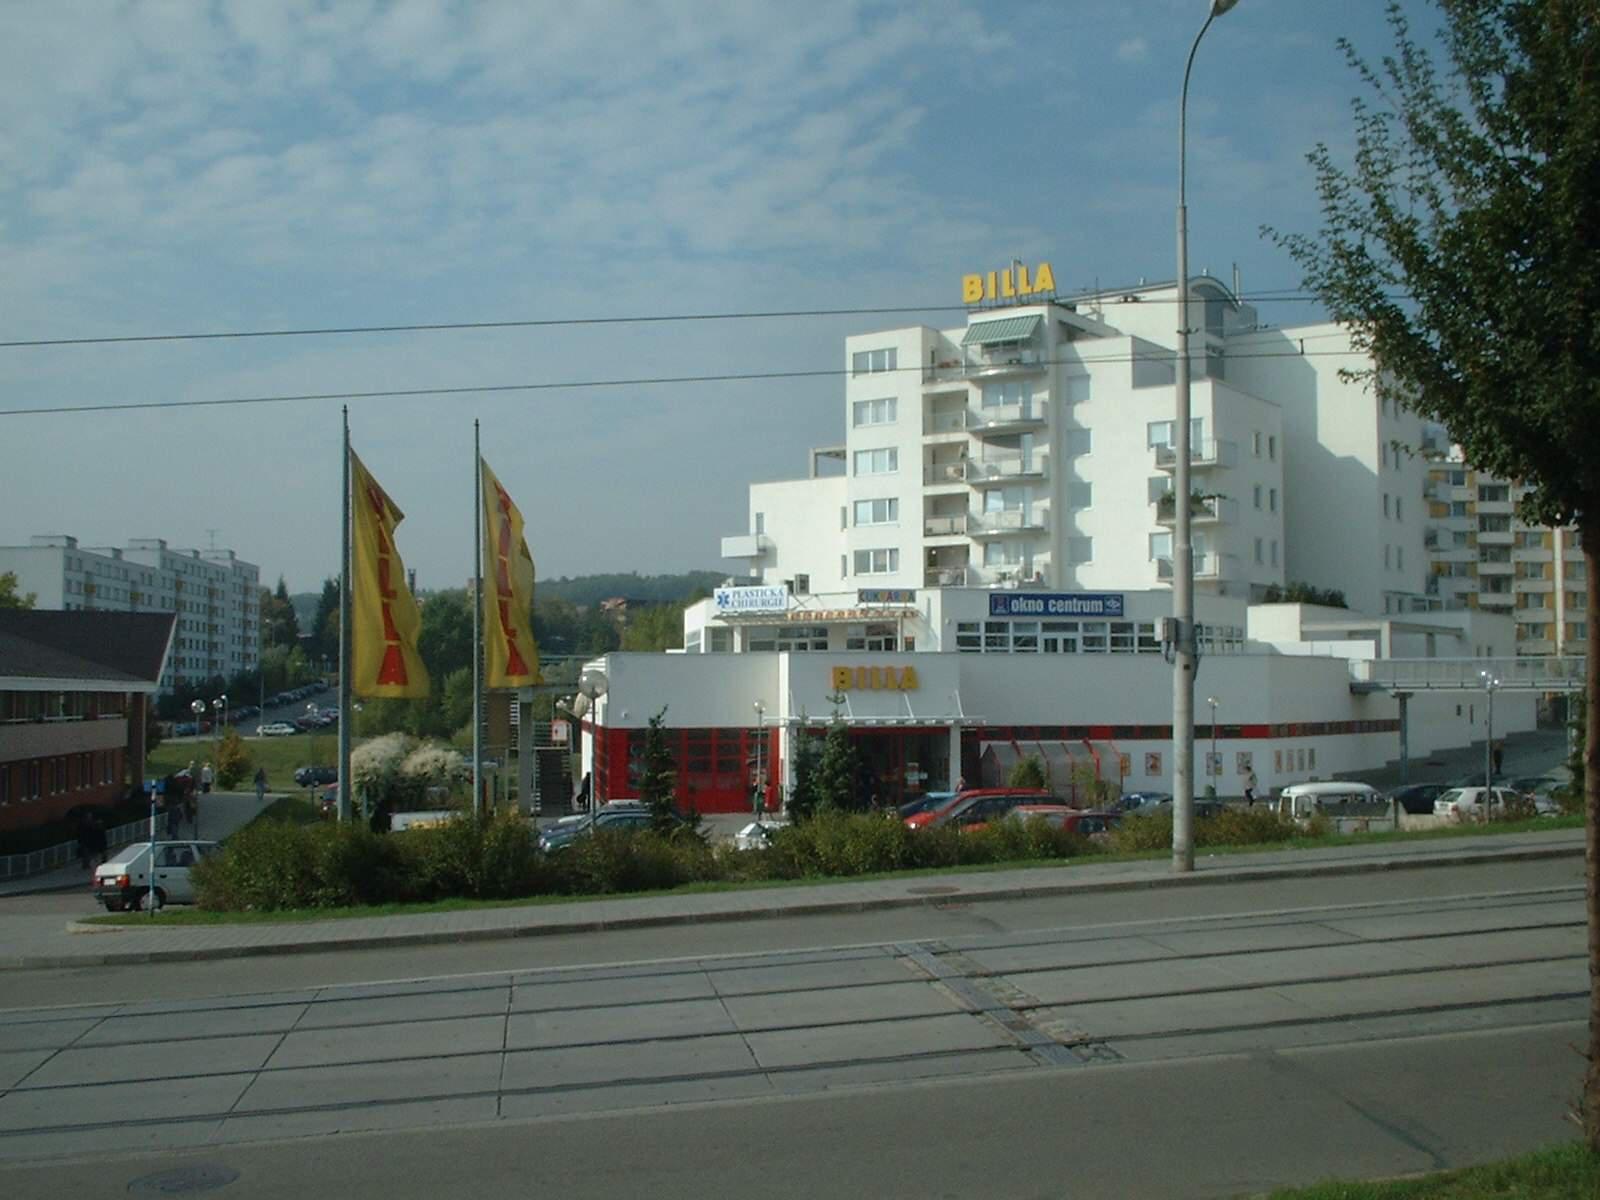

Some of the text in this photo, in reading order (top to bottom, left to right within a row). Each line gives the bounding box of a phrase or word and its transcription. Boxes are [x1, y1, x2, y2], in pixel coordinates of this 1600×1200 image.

[962, 262, 1055, 304] BILLA
[1010, 597, 1103, 613] okno centrum
[832, 666, 919, 689] BILLA
